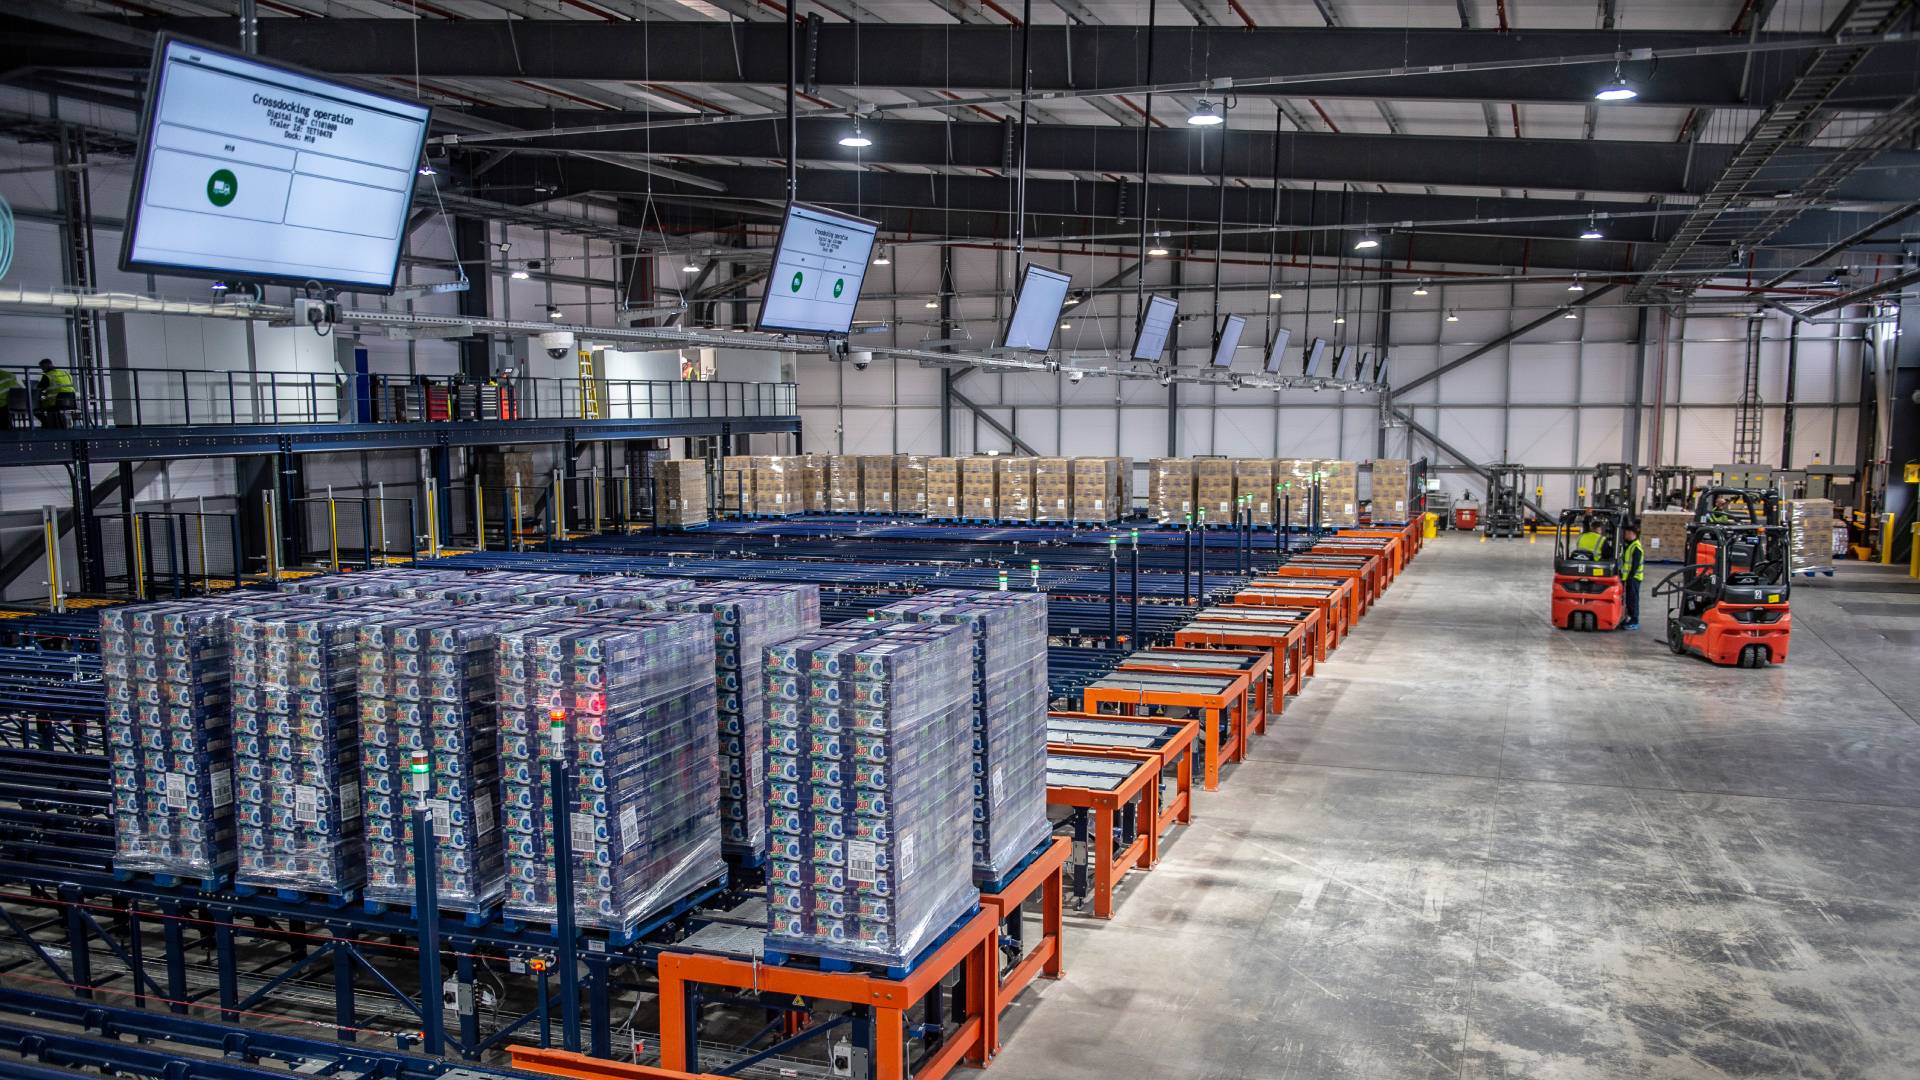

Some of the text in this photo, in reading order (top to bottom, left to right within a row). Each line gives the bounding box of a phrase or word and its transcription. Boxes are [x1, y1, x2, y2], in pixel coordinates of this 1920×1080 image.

[253, 93, 354, 126] Crossdocking operation
[267, 109, 292, 122] Digital
[294, 116, 308, 126] tag:
[284, 130, 302, 141] Dock:
